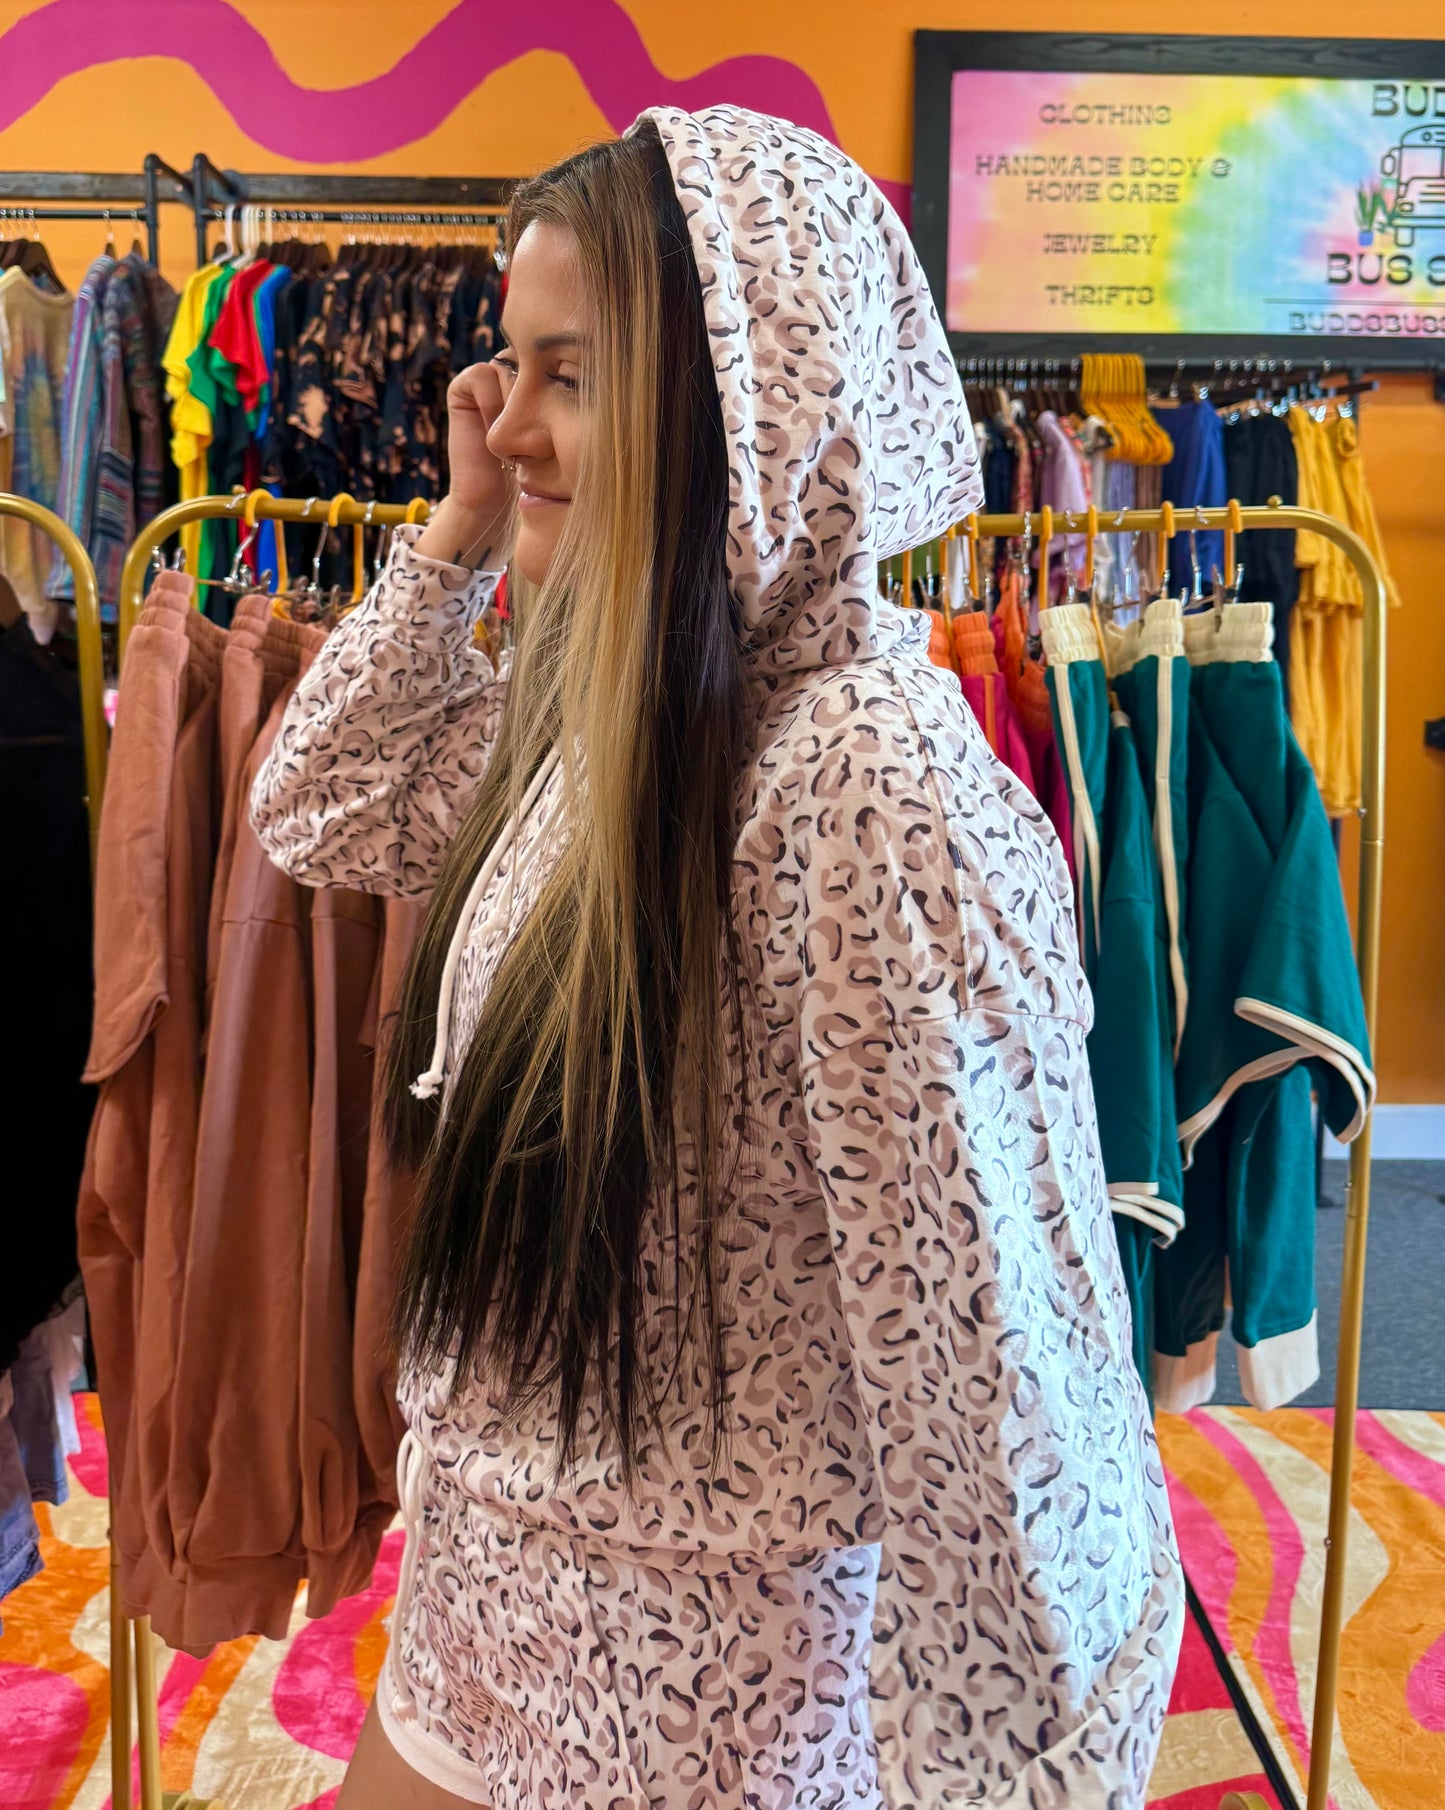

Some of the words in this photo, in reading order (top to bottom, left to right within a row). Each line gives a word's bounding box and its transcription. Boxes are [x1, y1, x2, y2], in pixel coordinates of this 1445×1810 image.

[1039, 103, 1172, 125] CLOTHING
[975, 155, 1123, 177] HANDMADE
[1129, 157, 1202, 178] BODY
[1026, 182, 1100, 202] HOME
[1106, 183, 1181, 203] CARE
[1043, 232, 1158, 255] JEWELRY
[1327, 253, 1412, 285] BUS
[1045, 285, 1155, 305] THRIFTS
